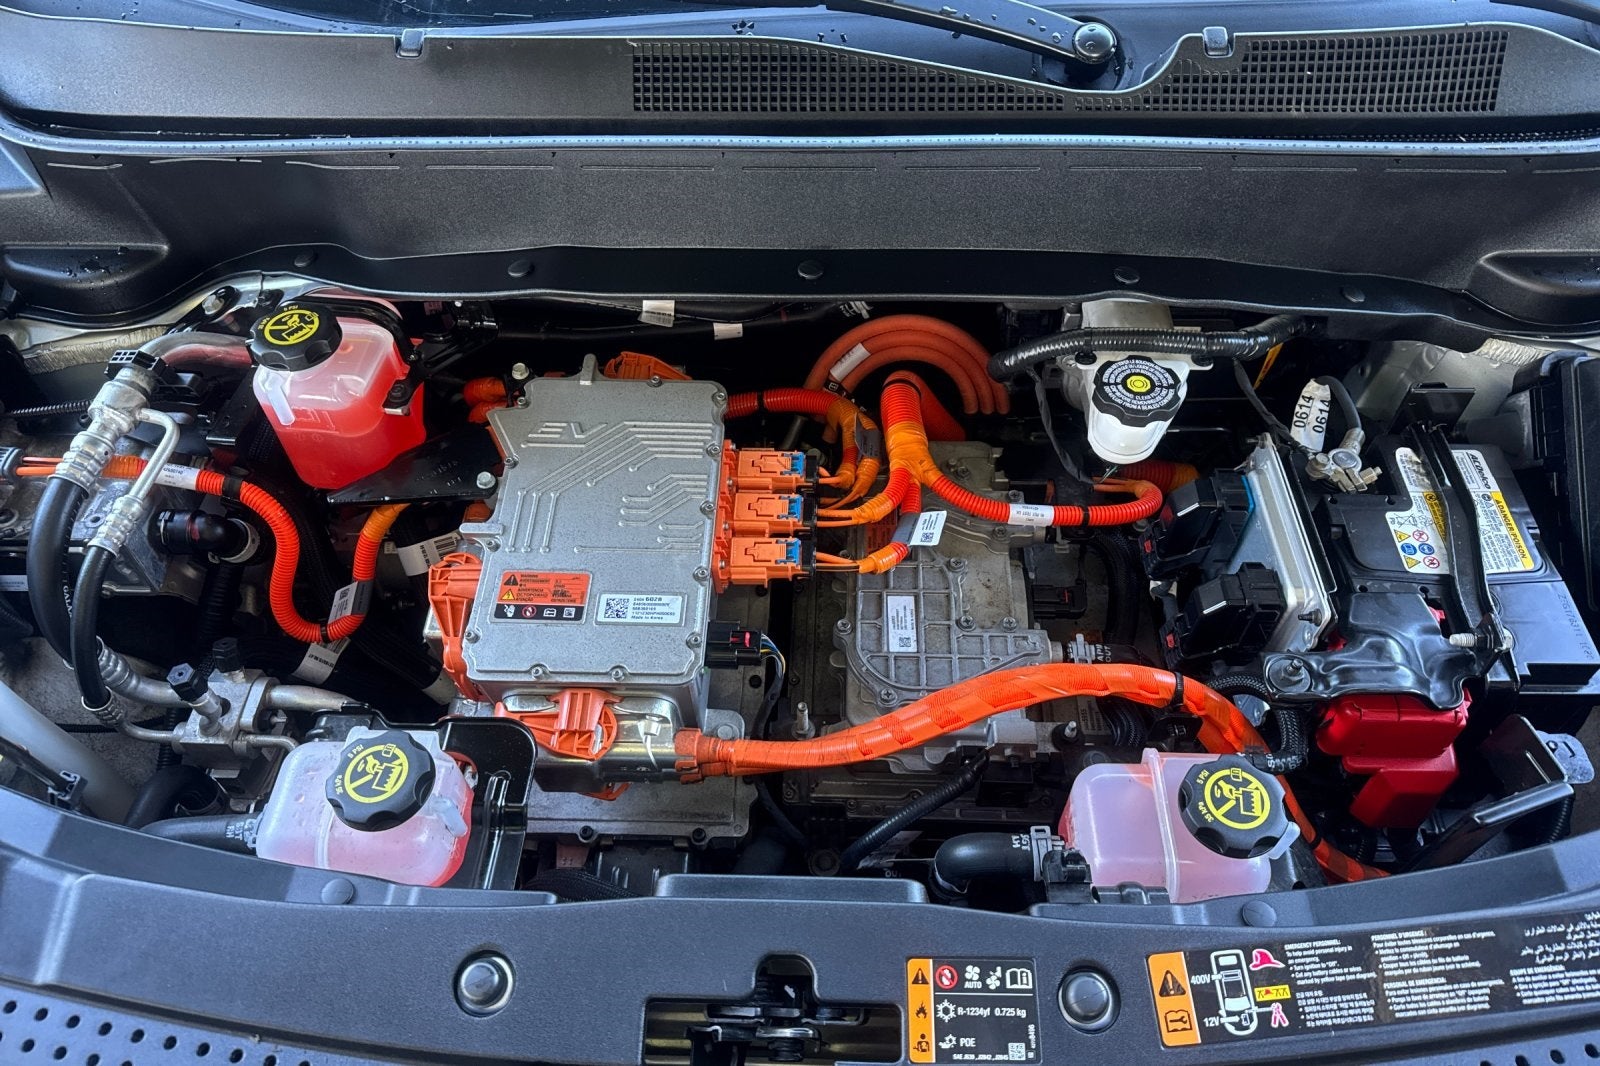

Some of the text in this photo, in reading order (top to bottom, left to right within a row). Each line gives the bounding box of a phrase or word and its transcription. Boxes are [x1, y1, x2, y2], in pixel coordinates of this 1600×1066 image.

[1294, 395, 1315, 428] 0614
[1312, 400, 1330, 433] 0614
[1469, 453, 1491, 490] ACDelco
[352, 744, 364, 754] PSI
[1200, 770, 1209, 781] PSI
[1198, 801, 1208, 815] kPa
[1191, 974, 1210, 984] 400V
[957, 1007, 1026, 1018] R-1234yf 0.725 kg
[1203, 1016, 1219, 1027] 12V
[960, 1038, 976, 1047] POE
